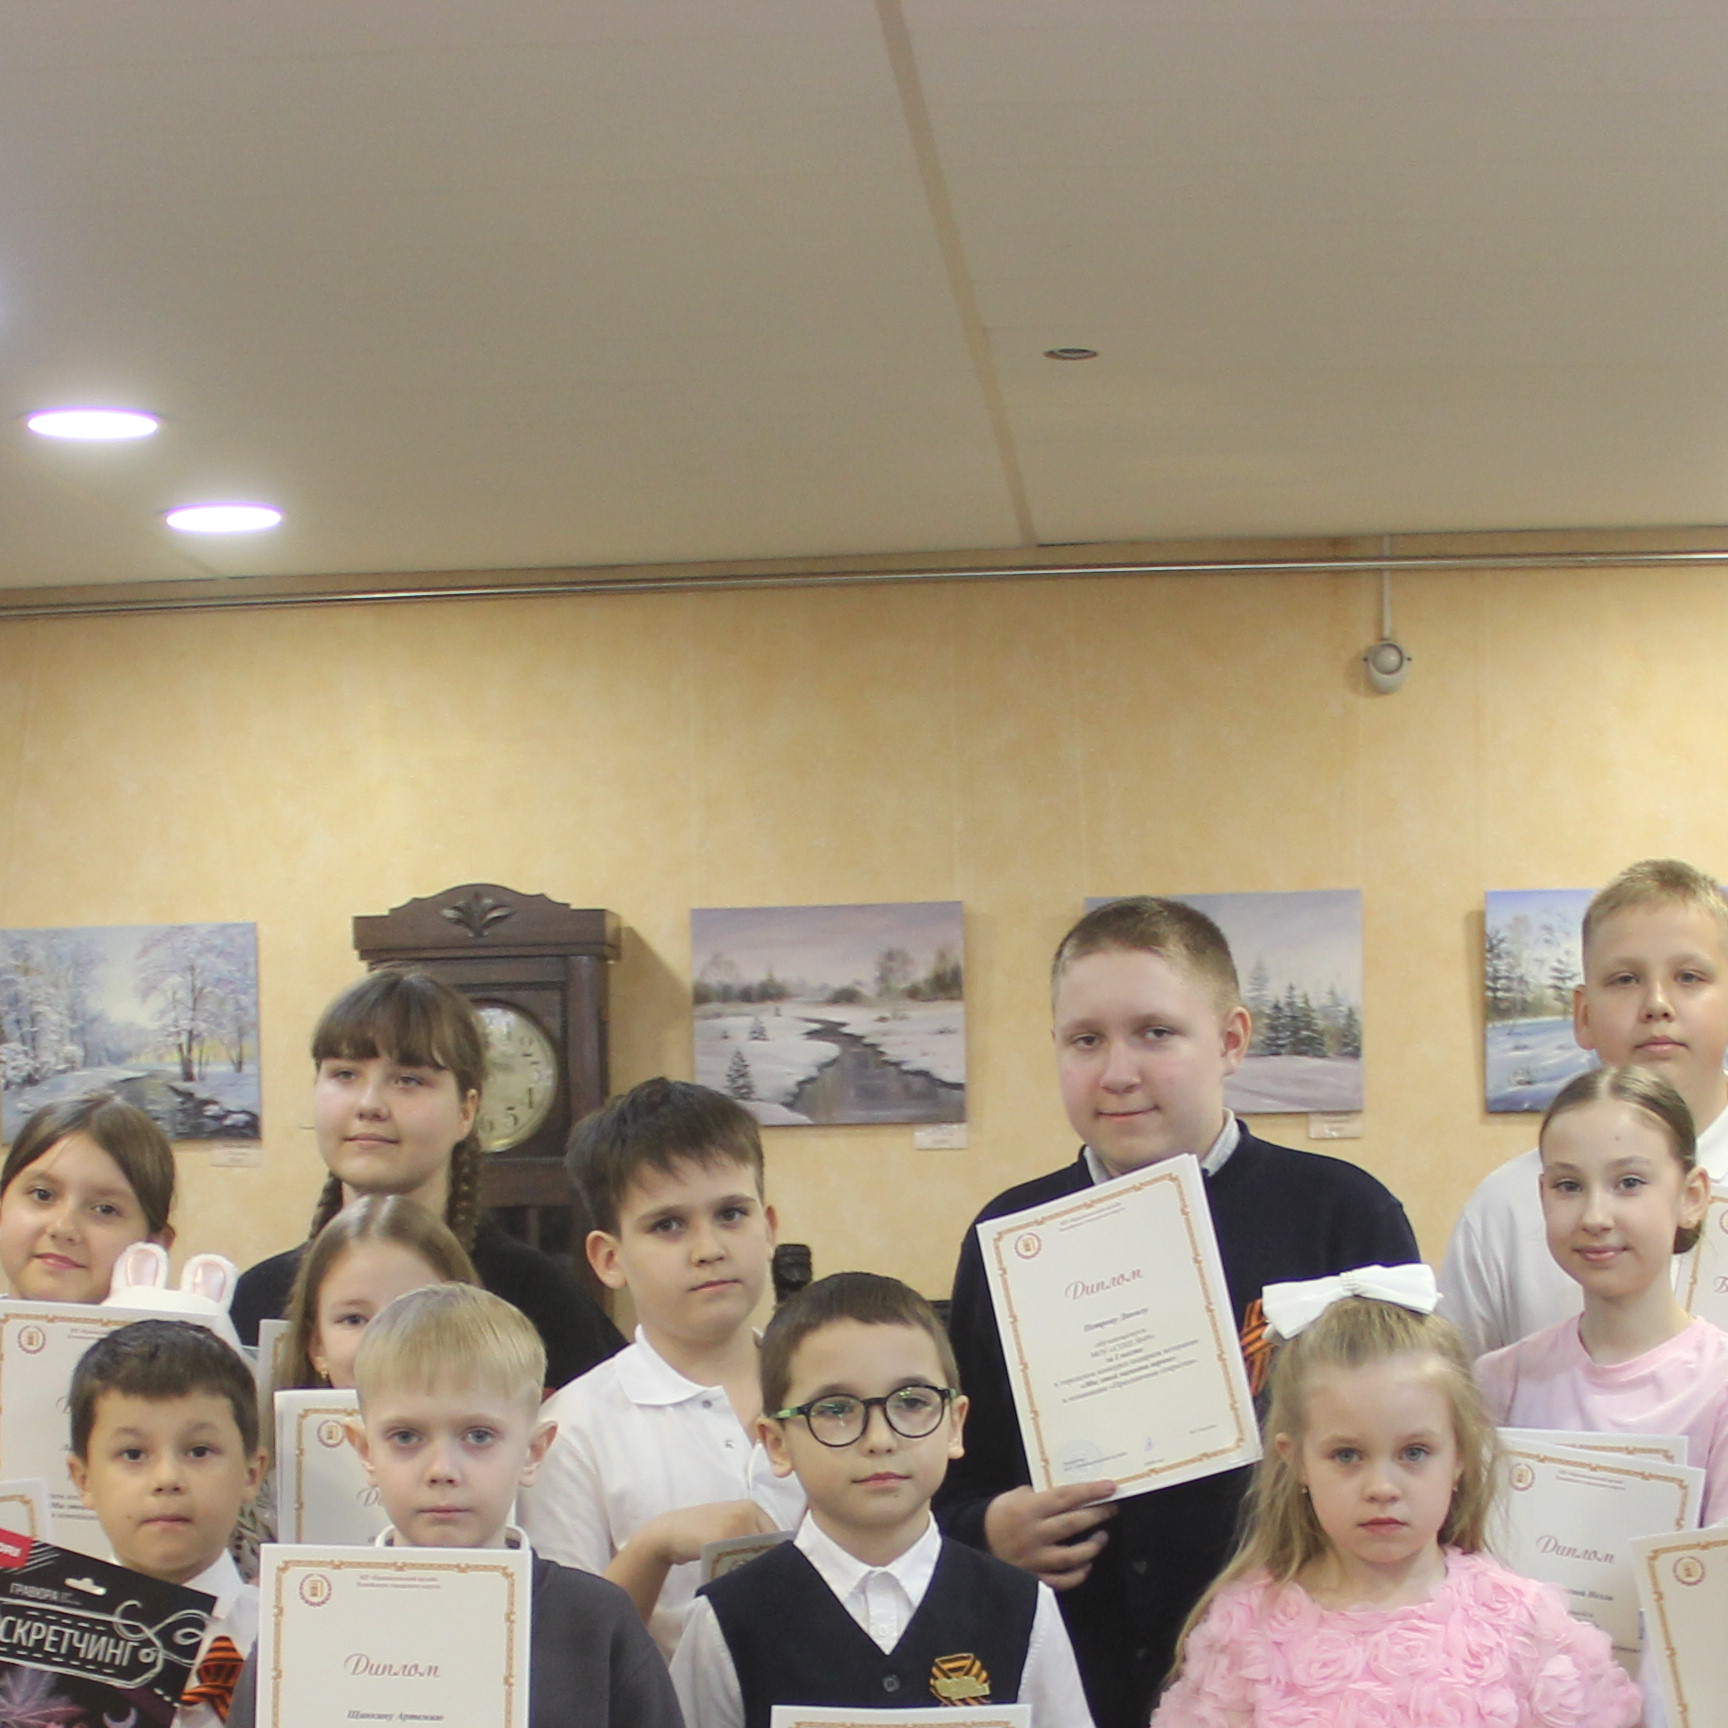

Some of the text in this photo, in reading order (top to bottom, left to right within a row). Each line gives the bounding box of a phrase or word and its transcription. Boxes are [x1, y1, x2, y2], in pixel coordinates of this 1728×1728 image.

[1064, 1268, 1143, 1300] Диплом
[1536, 1534, 1615, 1565] Диплом
[0, 1616, 141, 1667] СКРЕТЧИНГ
[344, 1653, 441, 1678] Диплом
